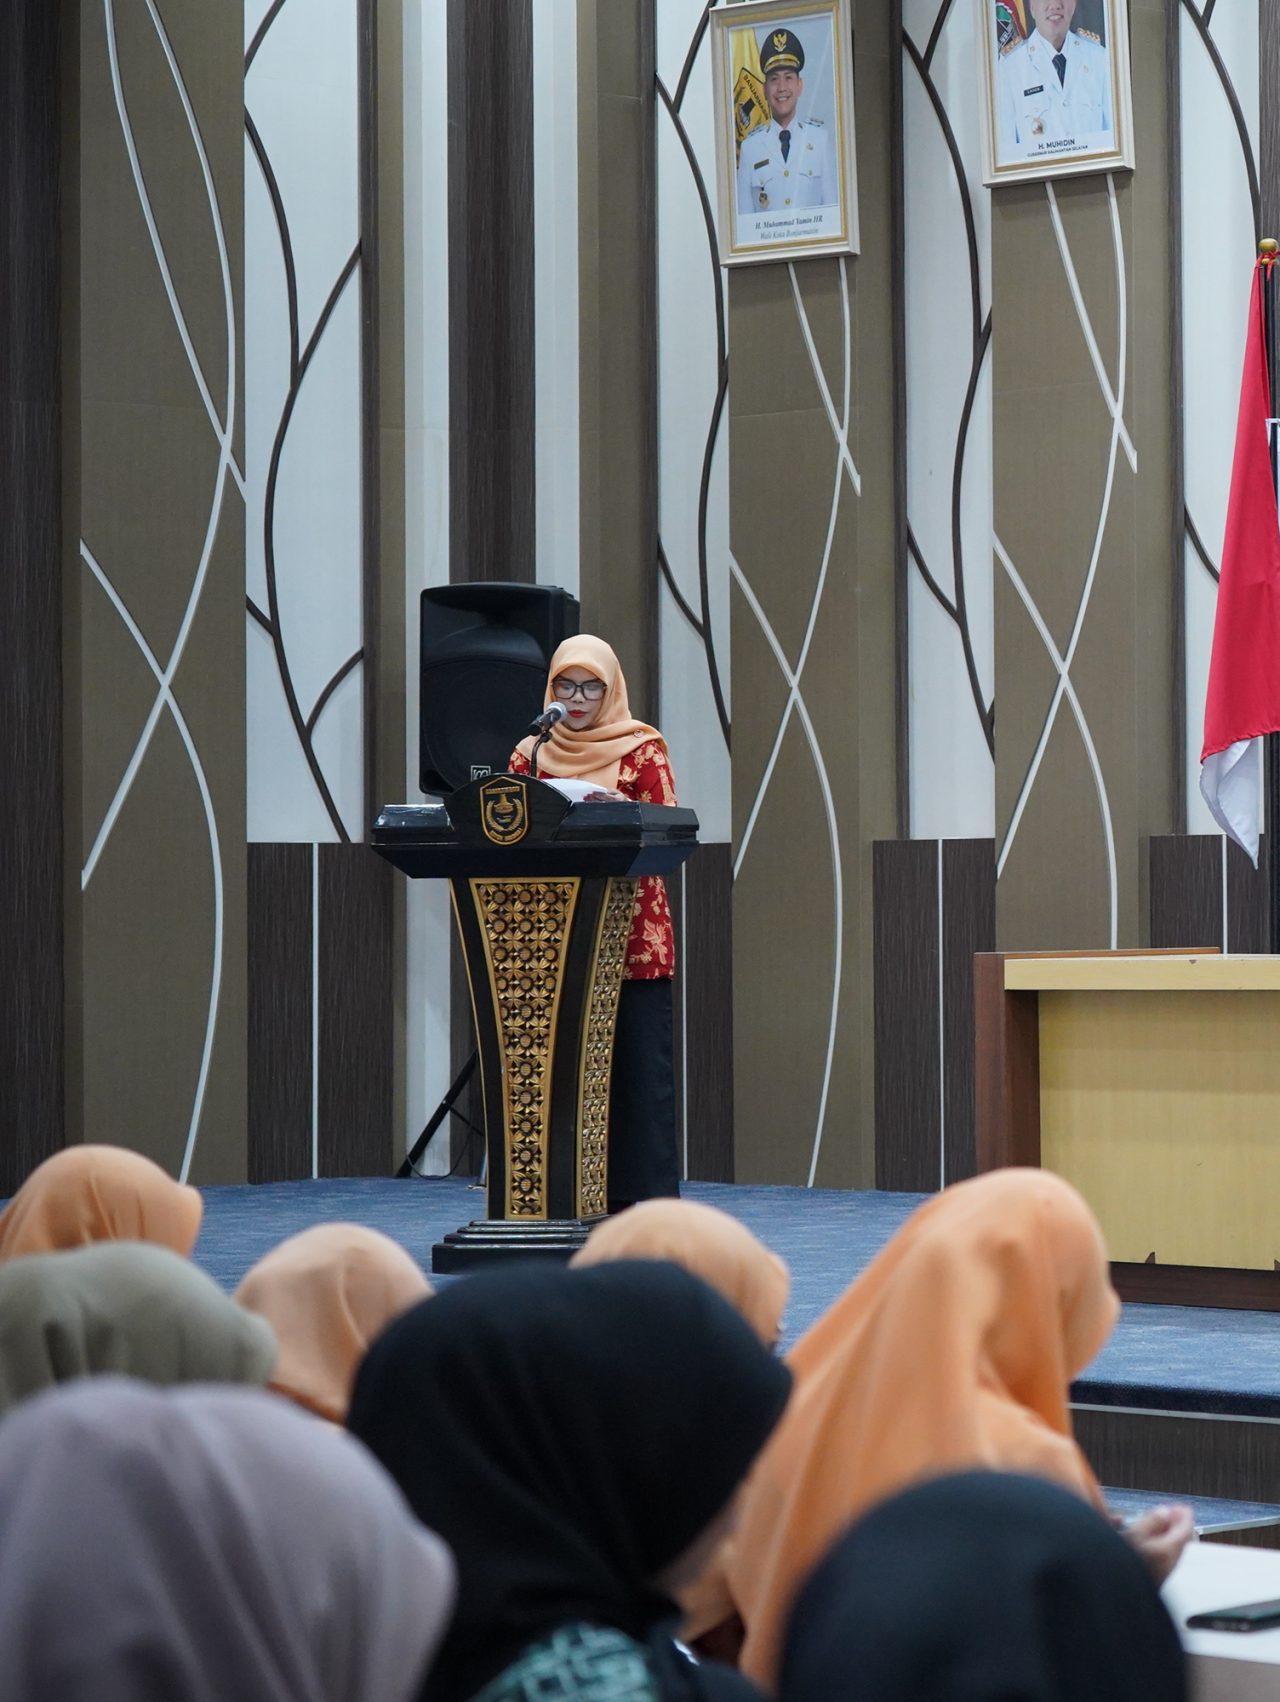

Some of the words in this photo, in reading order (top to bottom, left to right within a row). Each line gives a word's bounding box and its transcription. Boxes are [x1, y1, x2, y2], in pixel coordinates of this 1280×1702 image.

[1046, 138, 1075, 148] MUHIDIN
[764, 219, 795, 228] Muhammad
[796, 217, 812, 225] Yamin
